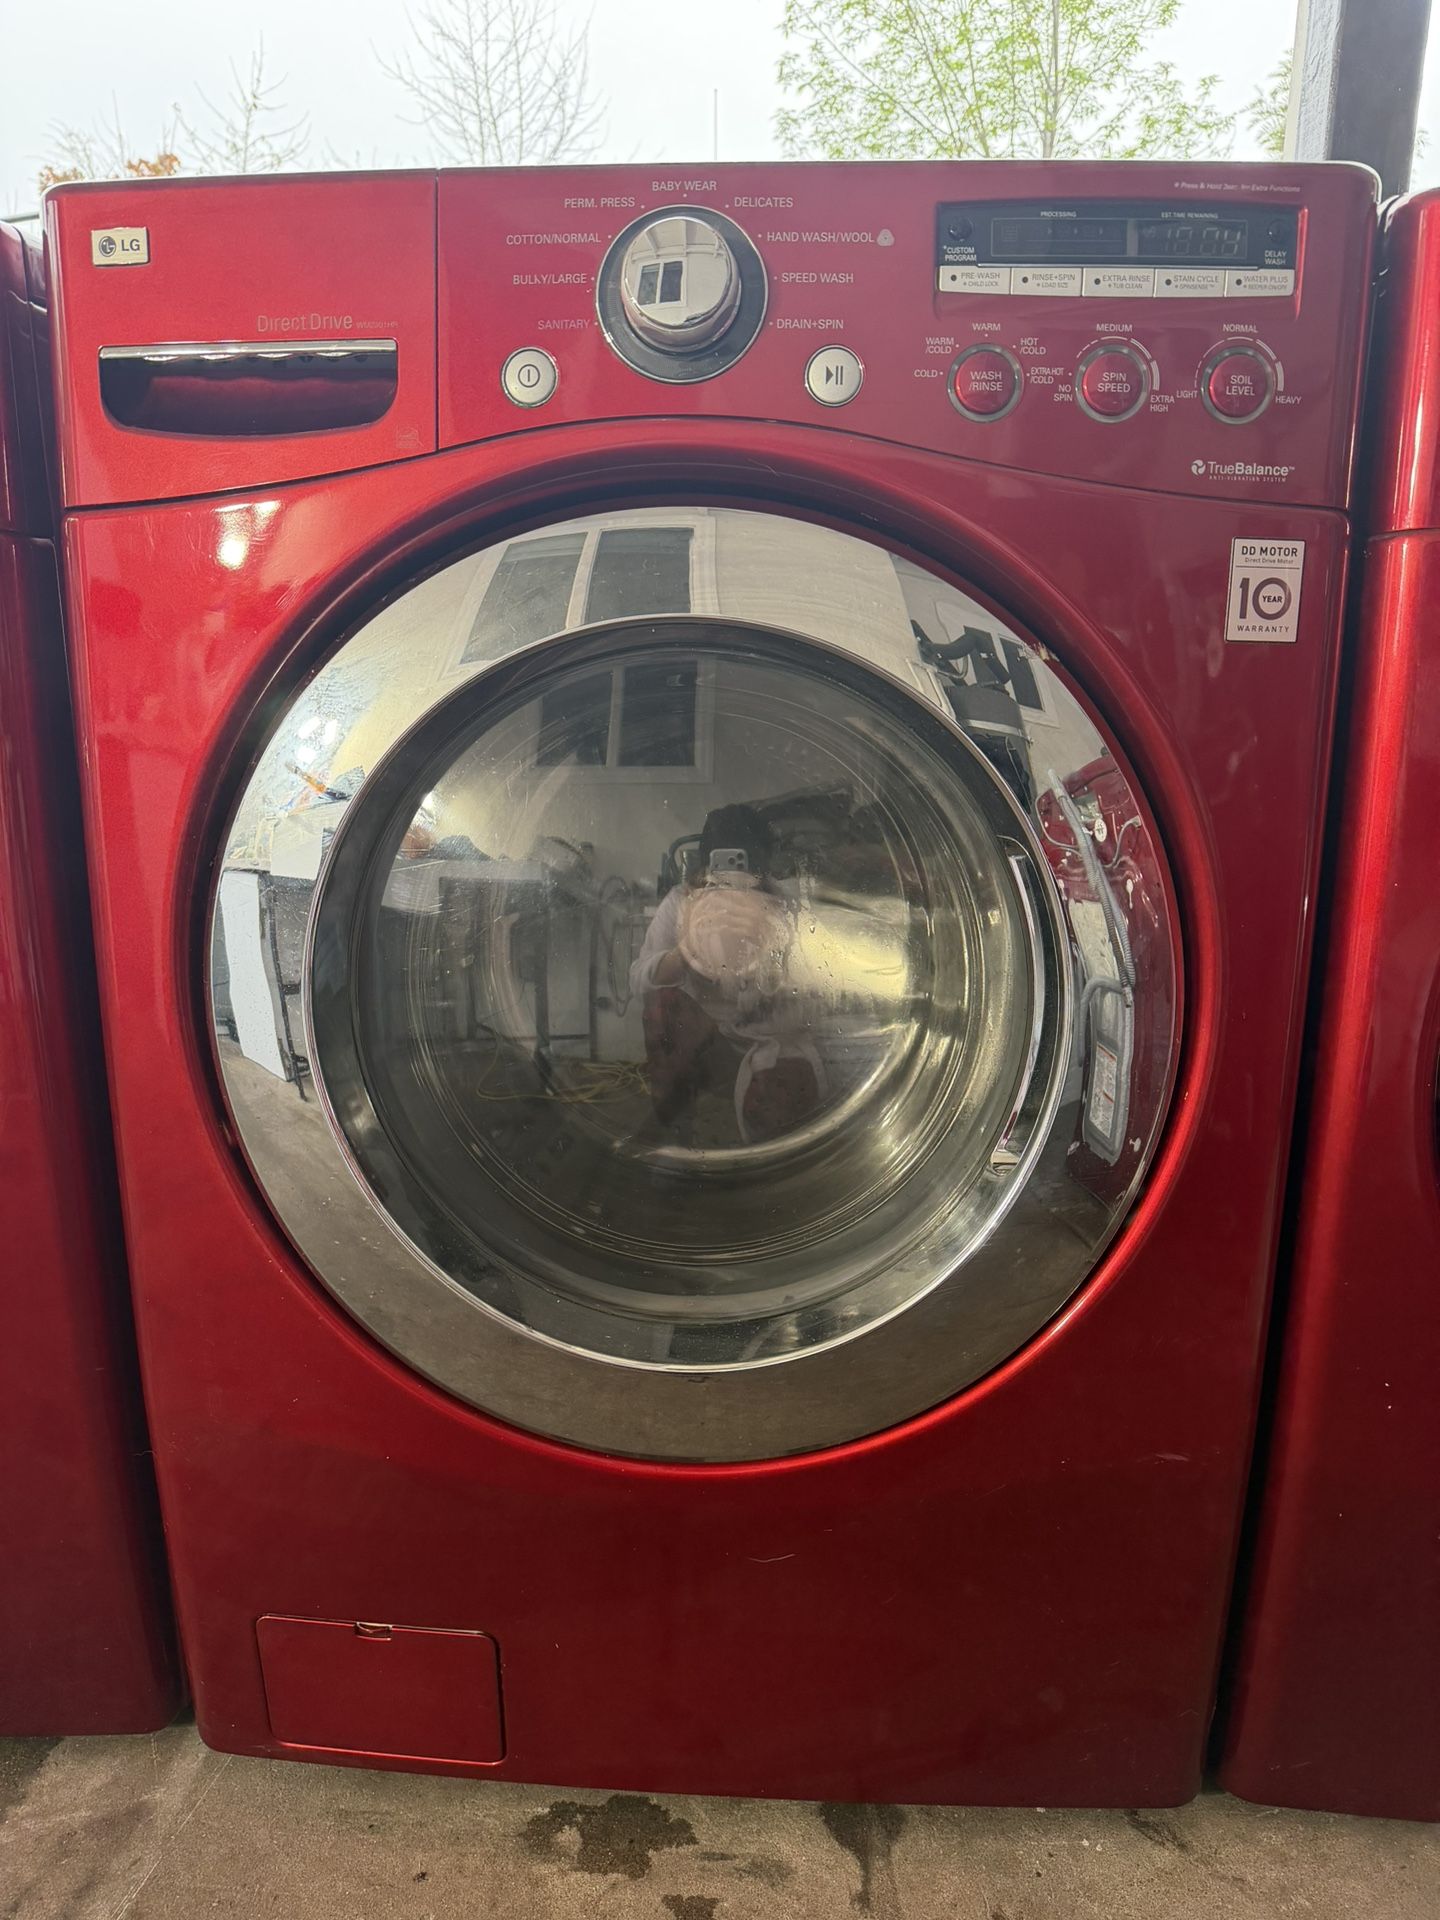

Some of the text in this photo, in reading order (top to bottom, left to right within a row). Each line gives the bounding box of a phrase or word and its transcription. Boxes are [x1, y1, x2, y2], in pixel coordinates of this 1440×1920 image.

[652, 180, 717, 191] BABY WEAR
[1269, 184, 1300, 192] Functions
[564, 197, 635, 208] PERM. PRESS
[734, 197, 793, 208] DELICATES
[506, 233, 601, 245] COTTON/NORMAL
[767, 232, 875, 243] HAND WASH/WOOL
[121, 239, 141, 251] LG
[513, 273, 587, 285] BULKY/LARGE
[782, 273, 854, 283] SPEED WASH
[1032, 273, 1076, 281] RINSE+SPIN
[1103, 274, 1127, 282] EXTRA
[1197, 275, 1219, 283] CYCLE
[257, 315, 307, 332] Direct
[311, 313, 353, 330] Drive
[538, 319, 590, 330] SANITARY
[777, 319, 844, 329] DRAIN+SPIN
[972, 323, 1000, 331] WARM
[1096, 324, 1133, 332] MEDIUM
[1222, 324, 1258, 333] NORMAL
[925, 337, 954, 345] WARM
[1020, 338, 1039, 346] HOT
[925, 345, 952, 354] /COLD
[1020, 346, 1046, 355] /COLD
[914, 369, 938, 377] COLD
[970, 371, 1002, 380] WASH
[1102, 372, 1127, 381] SPIN
[1030, 376, 1054, 384] /COLD
[1230, 375, 1253, 385] SOIL
[969, 381, 1003, 391] /RINSE
[1058, 384, 1071, 392] NO
[1097, 383, 1131, 393] SPEED
[1176, 390, 1198, 398] LIGHT
[1226, 386, 1255, 396] LEVEL
[1053, 393, 1073, 402] SPIN
[1150, 395, 1175, 404] EXTRA
[1275, 396, 1302, 405] HEAVY
[1150, 404, 1168, 412] HIGH
[1241, 545, 1298, 557] DD MOTOR
[1239, 577, 1292, 620] 10
[1262, 595, 1283, 603] YEAR
[1237, 625, 1290, 633] WARRANTY
